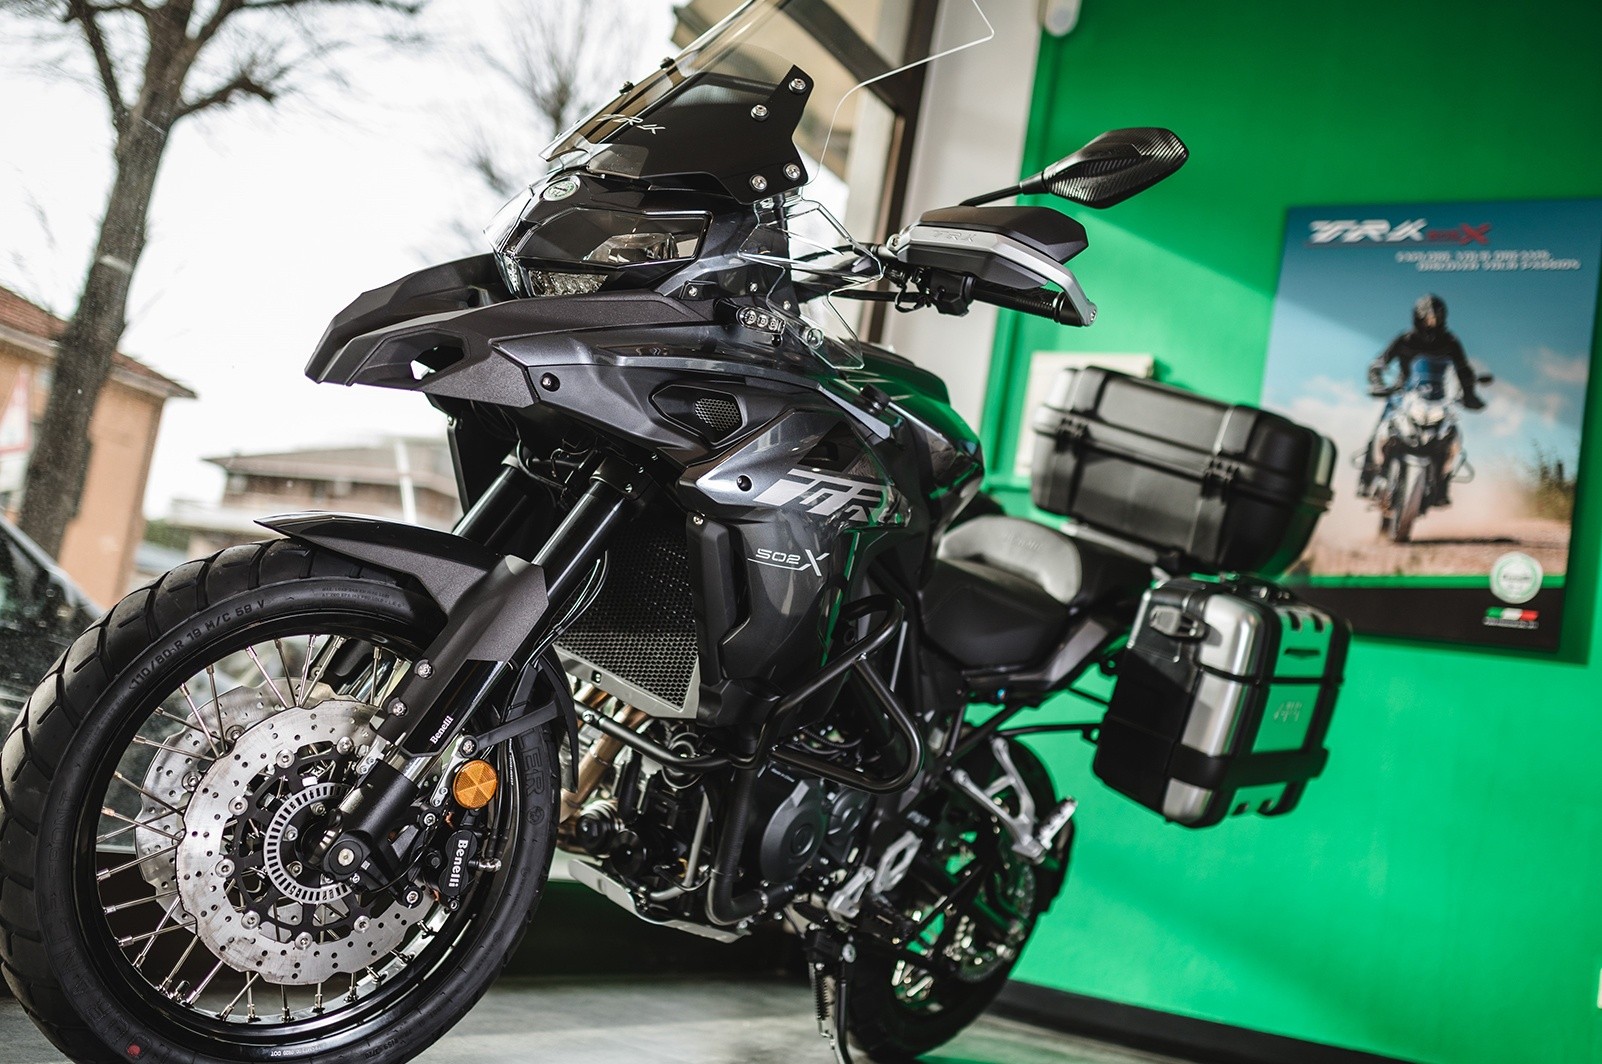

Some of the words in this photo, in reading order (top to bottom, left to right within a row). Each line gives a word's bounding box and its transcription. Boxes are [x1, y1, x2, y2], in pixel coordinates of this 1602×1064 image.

[1310, 218, 1428, 243] TRK
[205, 612, 232, 632] M/C
[257, 599, 265, 609] V
[430, 715, 454, 745] Benelli
[517, 728, 545, 796] LER
[448, 838, 469, 888] Benelli
